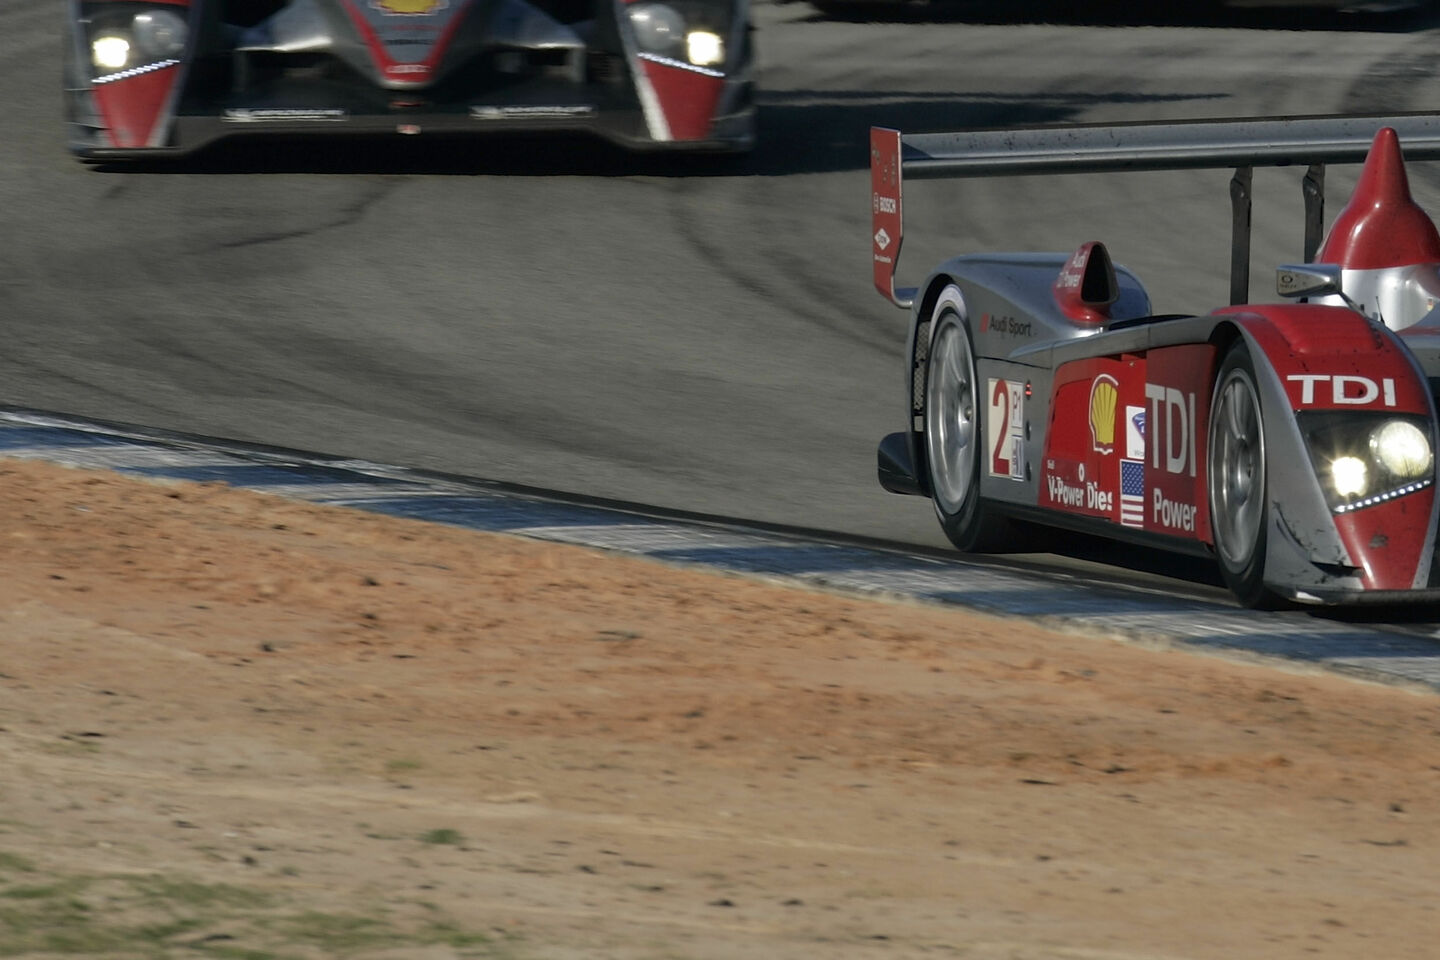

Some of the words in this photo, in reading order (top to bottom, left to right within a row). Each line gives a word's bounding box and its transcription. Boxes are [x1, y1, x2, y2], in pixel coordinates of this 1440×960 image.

[989, 315, 1008, 332] Audi
[1008, 317, 1032, 337] Sport
[1286, 374, 1397, 407] TDI
[992, 379, 1010, 476] 2
[1145, 382, 1197, 478] TDI
[1047, 475, 1085, 508] V-Power
[1153, 487, 1198, 532] Power
